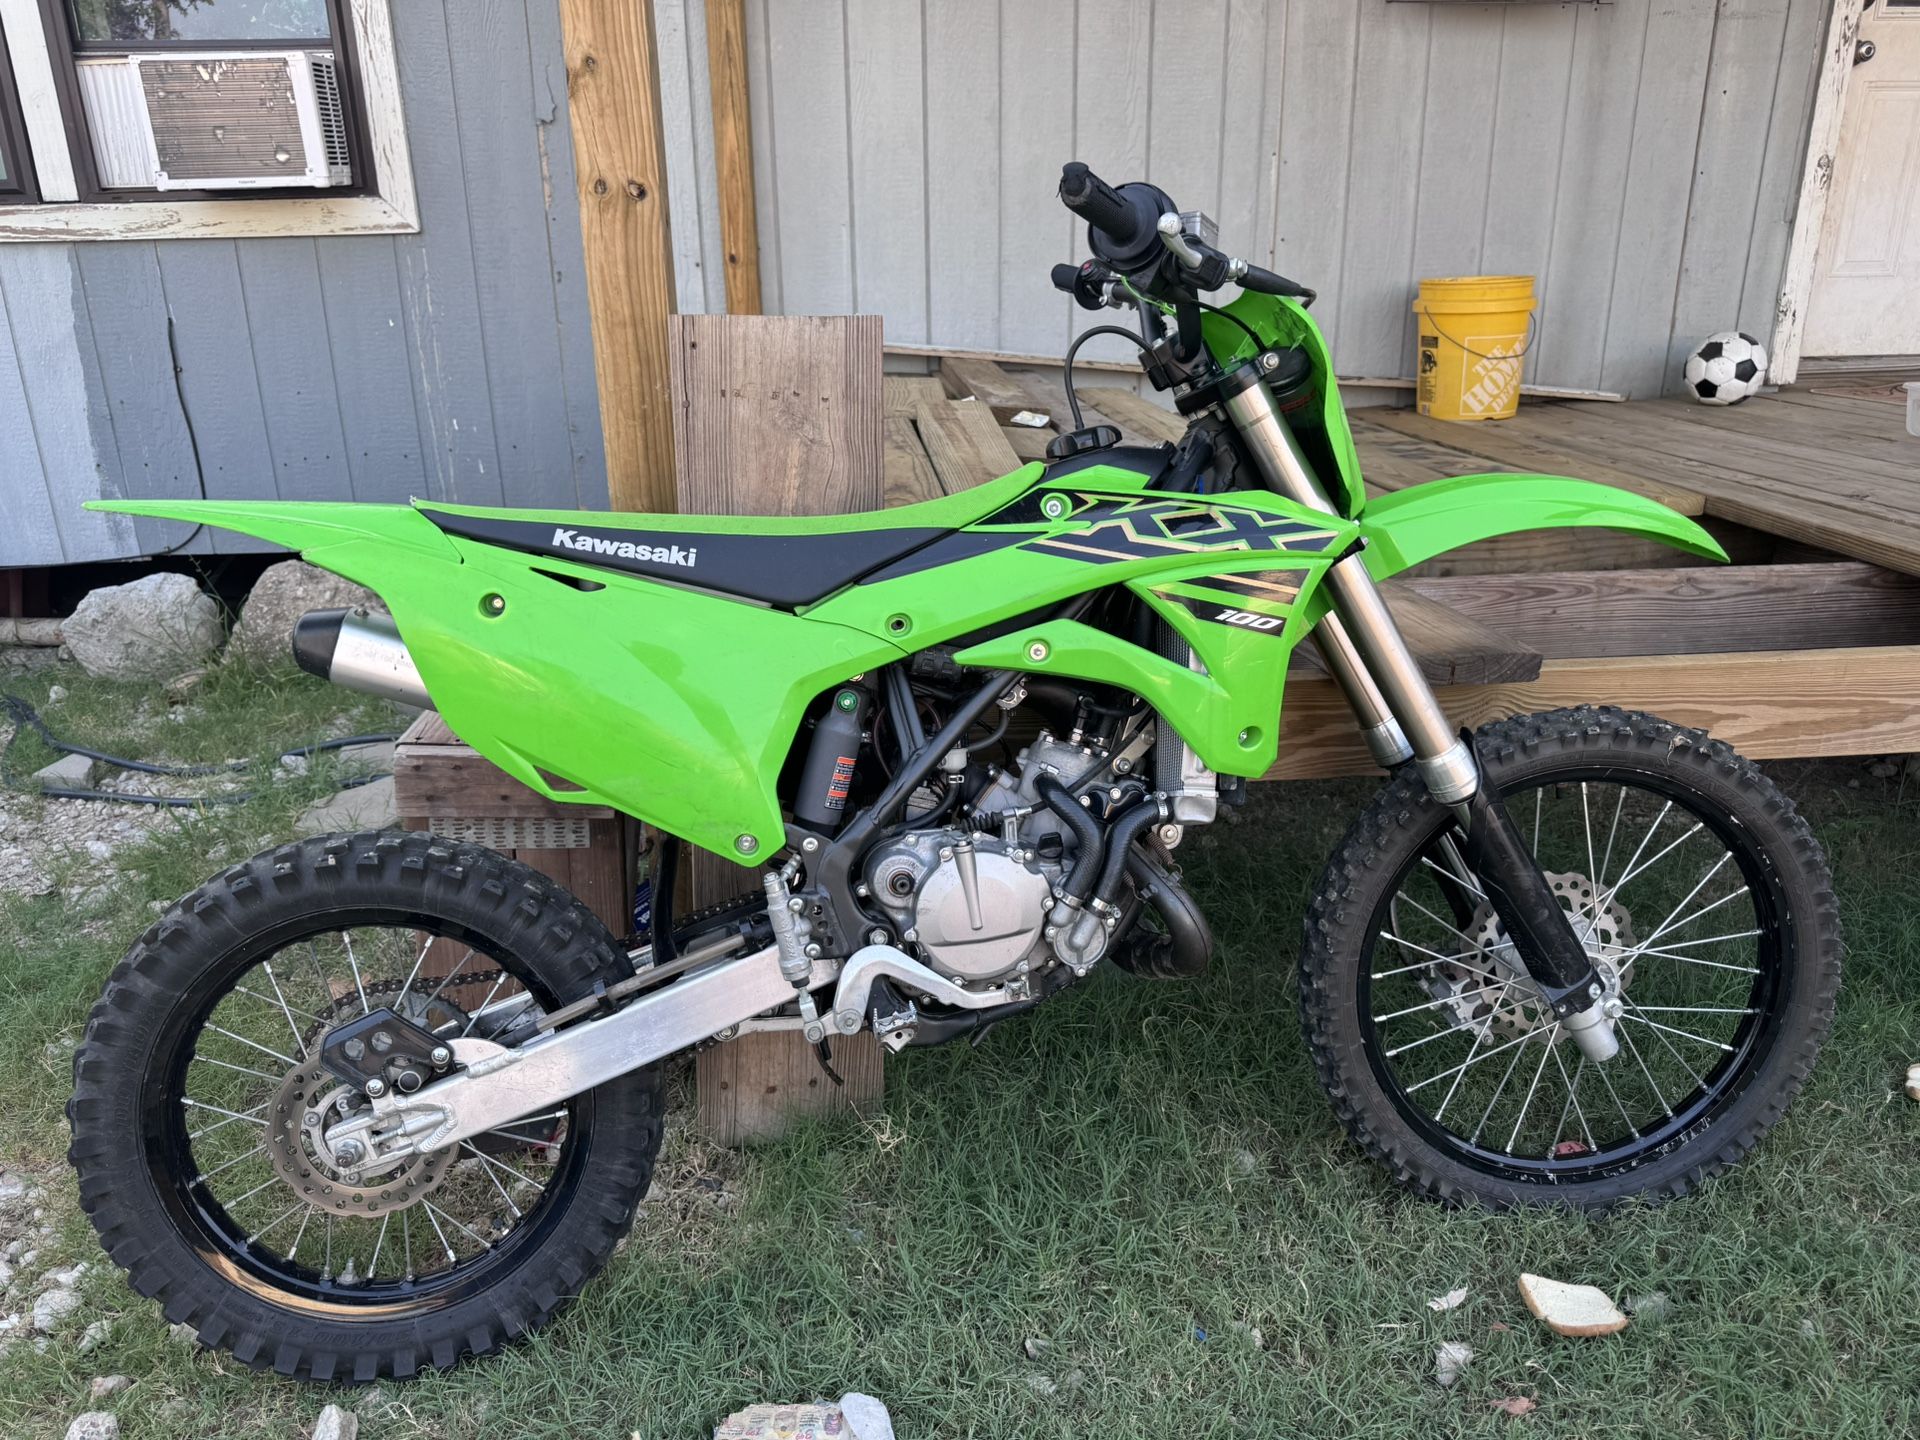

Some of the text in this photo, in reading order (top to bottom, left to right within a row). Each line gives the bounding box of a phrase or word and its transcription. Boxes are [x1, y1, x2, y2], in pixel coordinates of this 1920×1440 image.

[1462, 335, 1525, 414] HOME
[1472, 344, 1506, 377] THE
[552, 528, 697, 567] Kawasaki
[1214, 608, 1284, 629] 100
